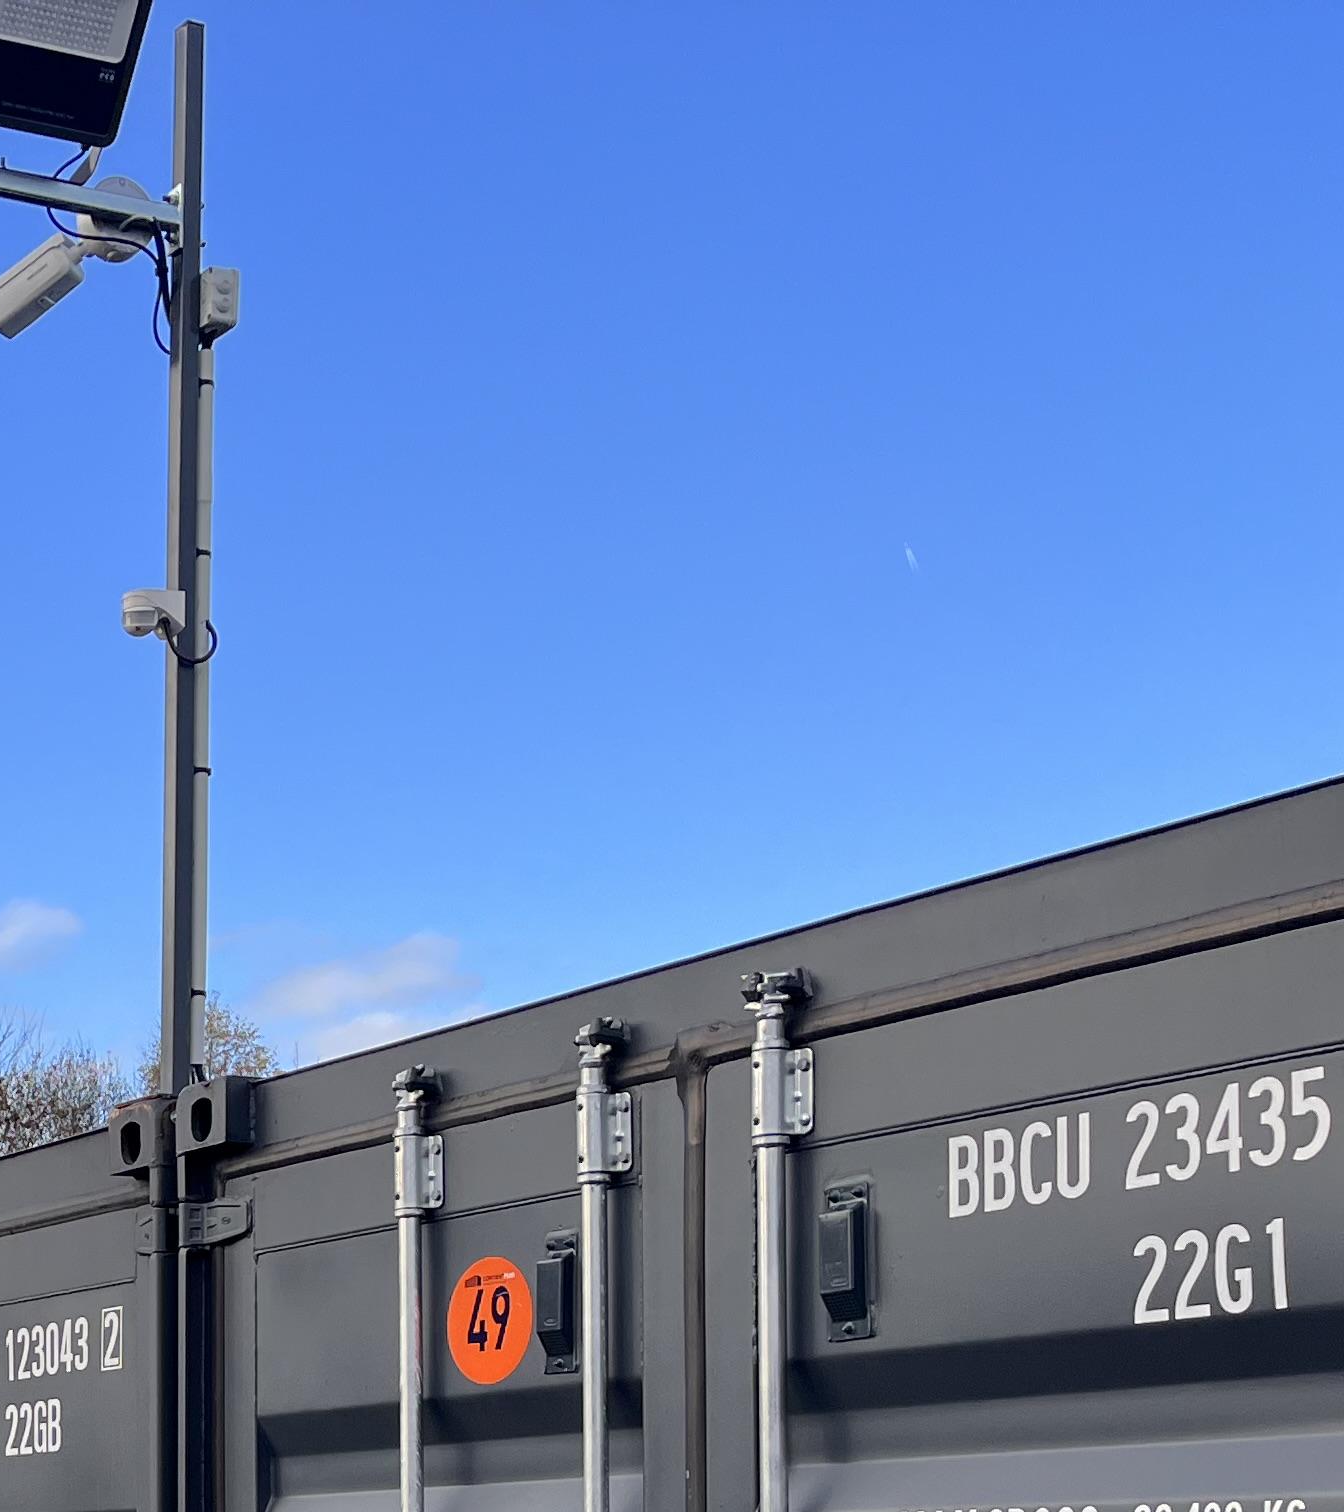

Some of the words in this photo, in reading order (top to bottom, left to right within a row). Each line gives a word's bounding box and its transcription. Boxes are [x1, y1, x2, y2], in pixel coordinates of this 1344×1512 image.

[948, 1112, 1091, 1218] BBCU
[1125, 1066, 1332, 1190] 23435
[1132, 1217, 1289, 1324] 22G1
[5, 1316, 89, 1382] 123043
[103, 1310, 121, 1368] 2
[467, 1285, 510, 1352] 49
[4, 1398, 62, 1457] 22GB
